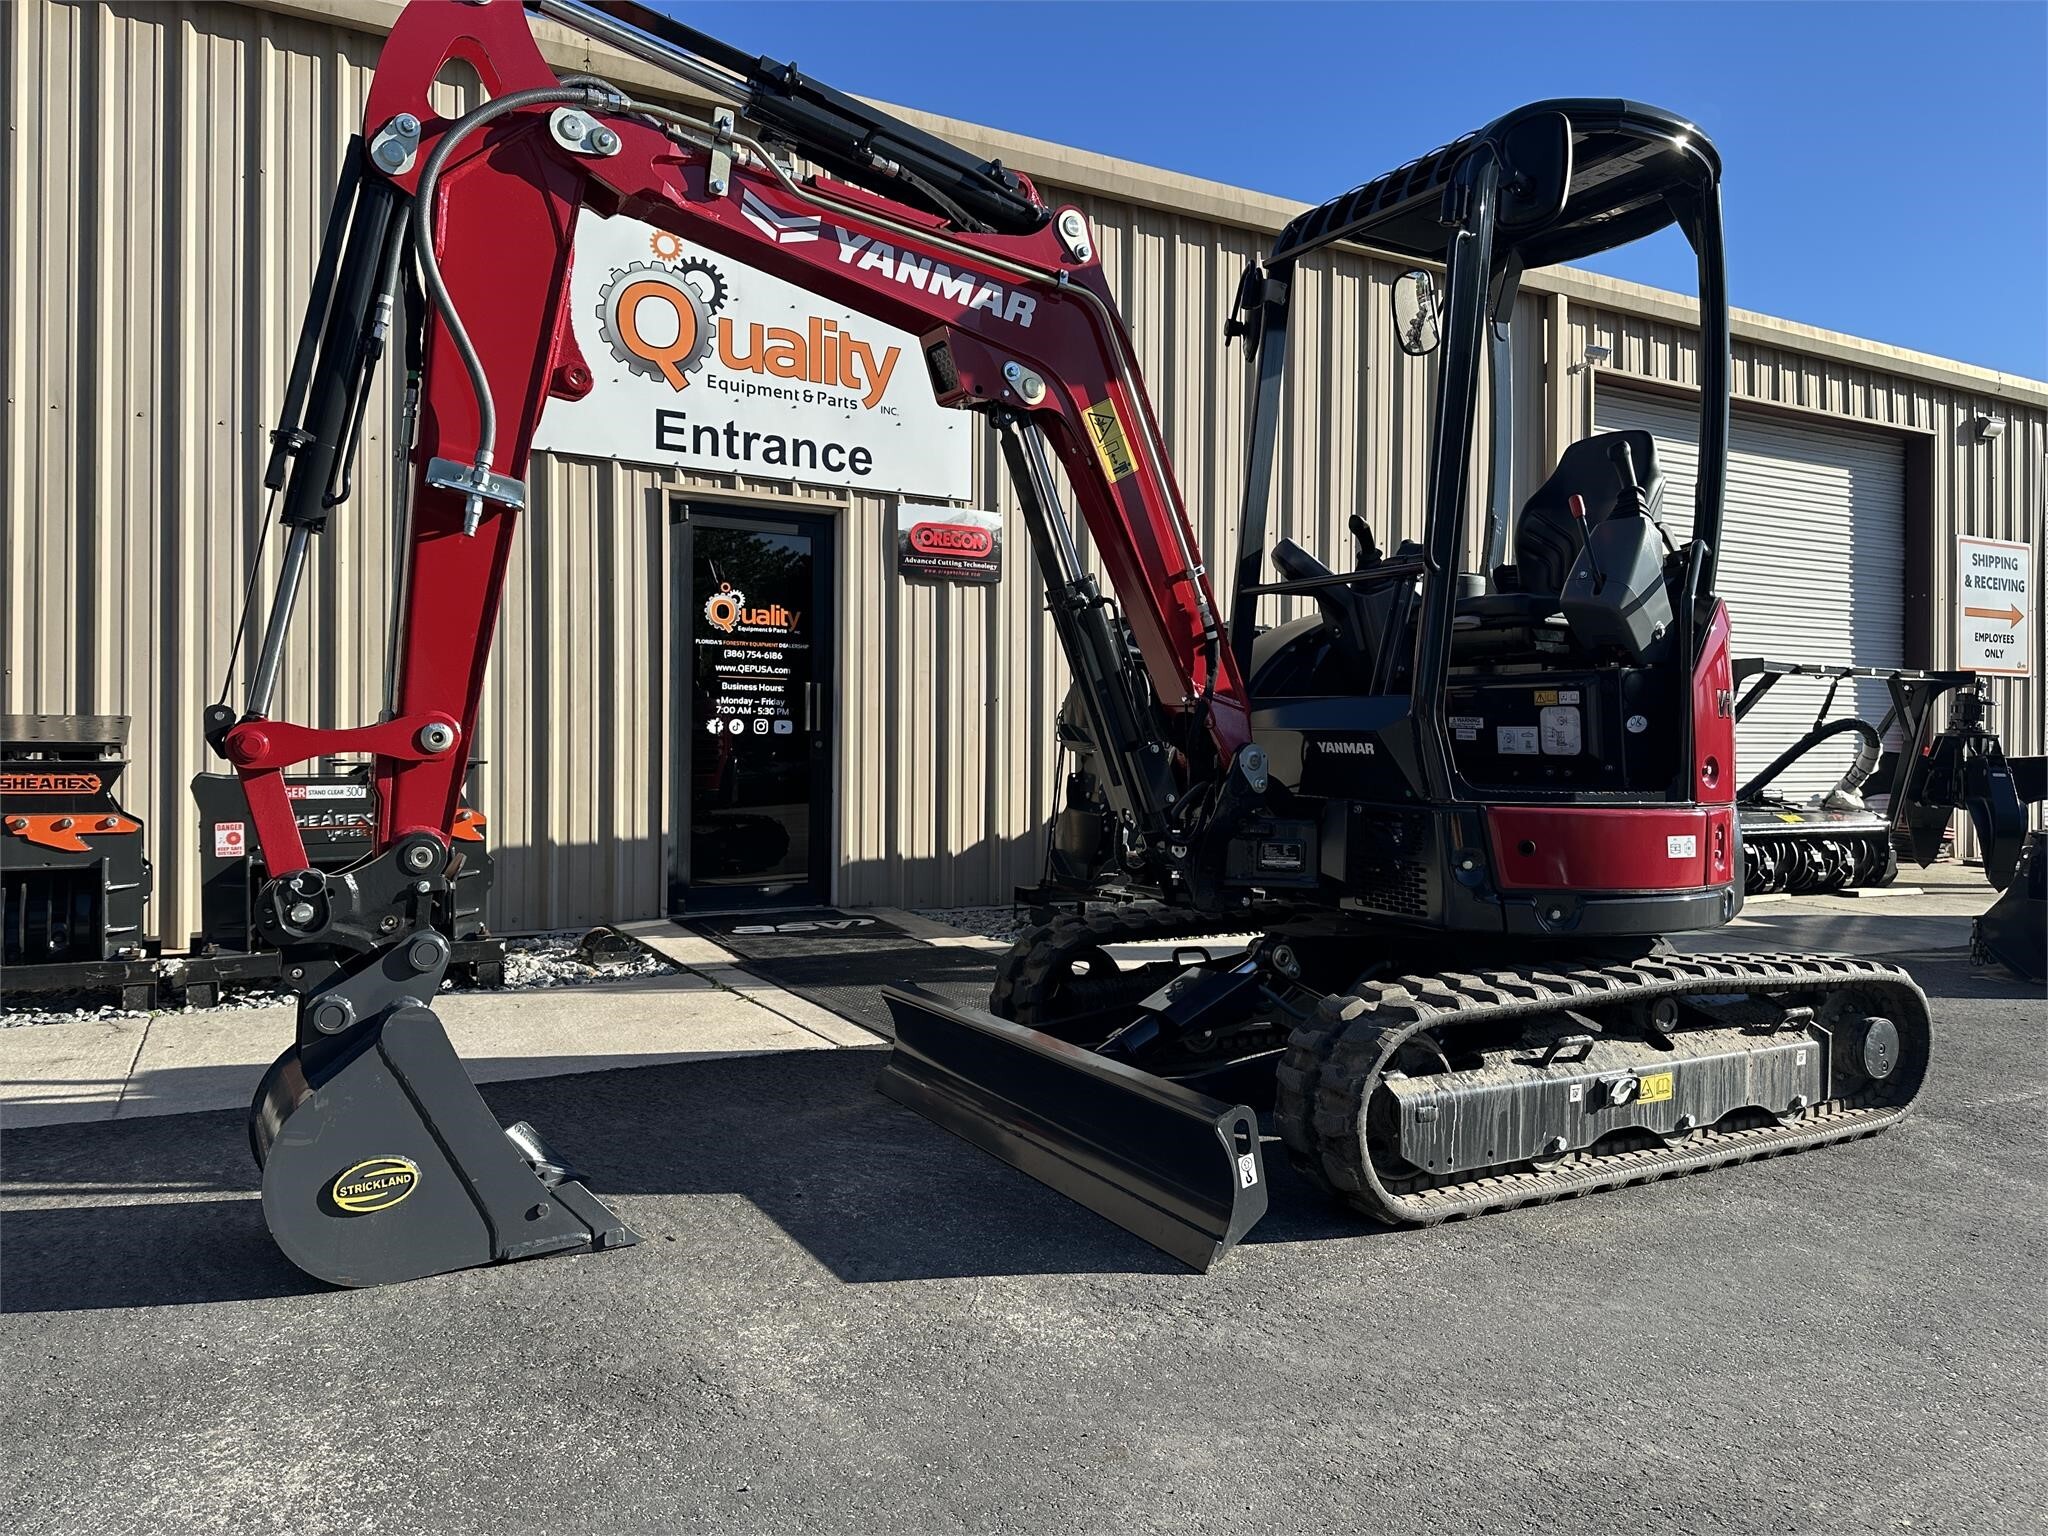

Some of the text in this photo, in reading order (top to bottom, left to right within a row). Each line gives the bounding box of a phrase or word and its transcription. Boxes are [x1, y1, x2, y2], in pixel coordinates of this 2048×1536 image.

[834, 225, 1037, 328] YANMAR
[616, 279, 901, 409] Quality
[707, 374, 899, 416] Equipment & Parts INC.
[656, 408, 873, 476] Entrance
[920, 529, 983, 550] OREGON
[905, 557, 998, 571] Advanced Cutting Technology
[1972, 553, 2018, 571] SHIPPING
[1965, 574, 2025, 593] & RECEIVING
[710, 598, 800, 634] Quality
[738, 625, 768, 633] Equipment
[695, 638, 723, 646] FLORIDA'S
[1974, 632, 2014, 644] EMPLOYEES
[724, 649, 783, 660] (386) 754-6186
[1984, 648, 2004, 659] ONLY
[715, 664, 791, 675] www.QEPUSA.com
[721, 681, 785, 692] Business Hours:
[720, 696, 753, 707] Monday
[761, 697, 785, 707] Friday
[716, 706, 736, 714] 7:00
[736, 706, 752, 715] AM
[757, 707, 775, 716] 5:30
[776, 708, 789, 716] PM
[1317, 741, 1375, 755] YANMAR
[0, 777, 98, 790] SHEAREX
[339, 1174, 412, 1197] STRICKLAND
